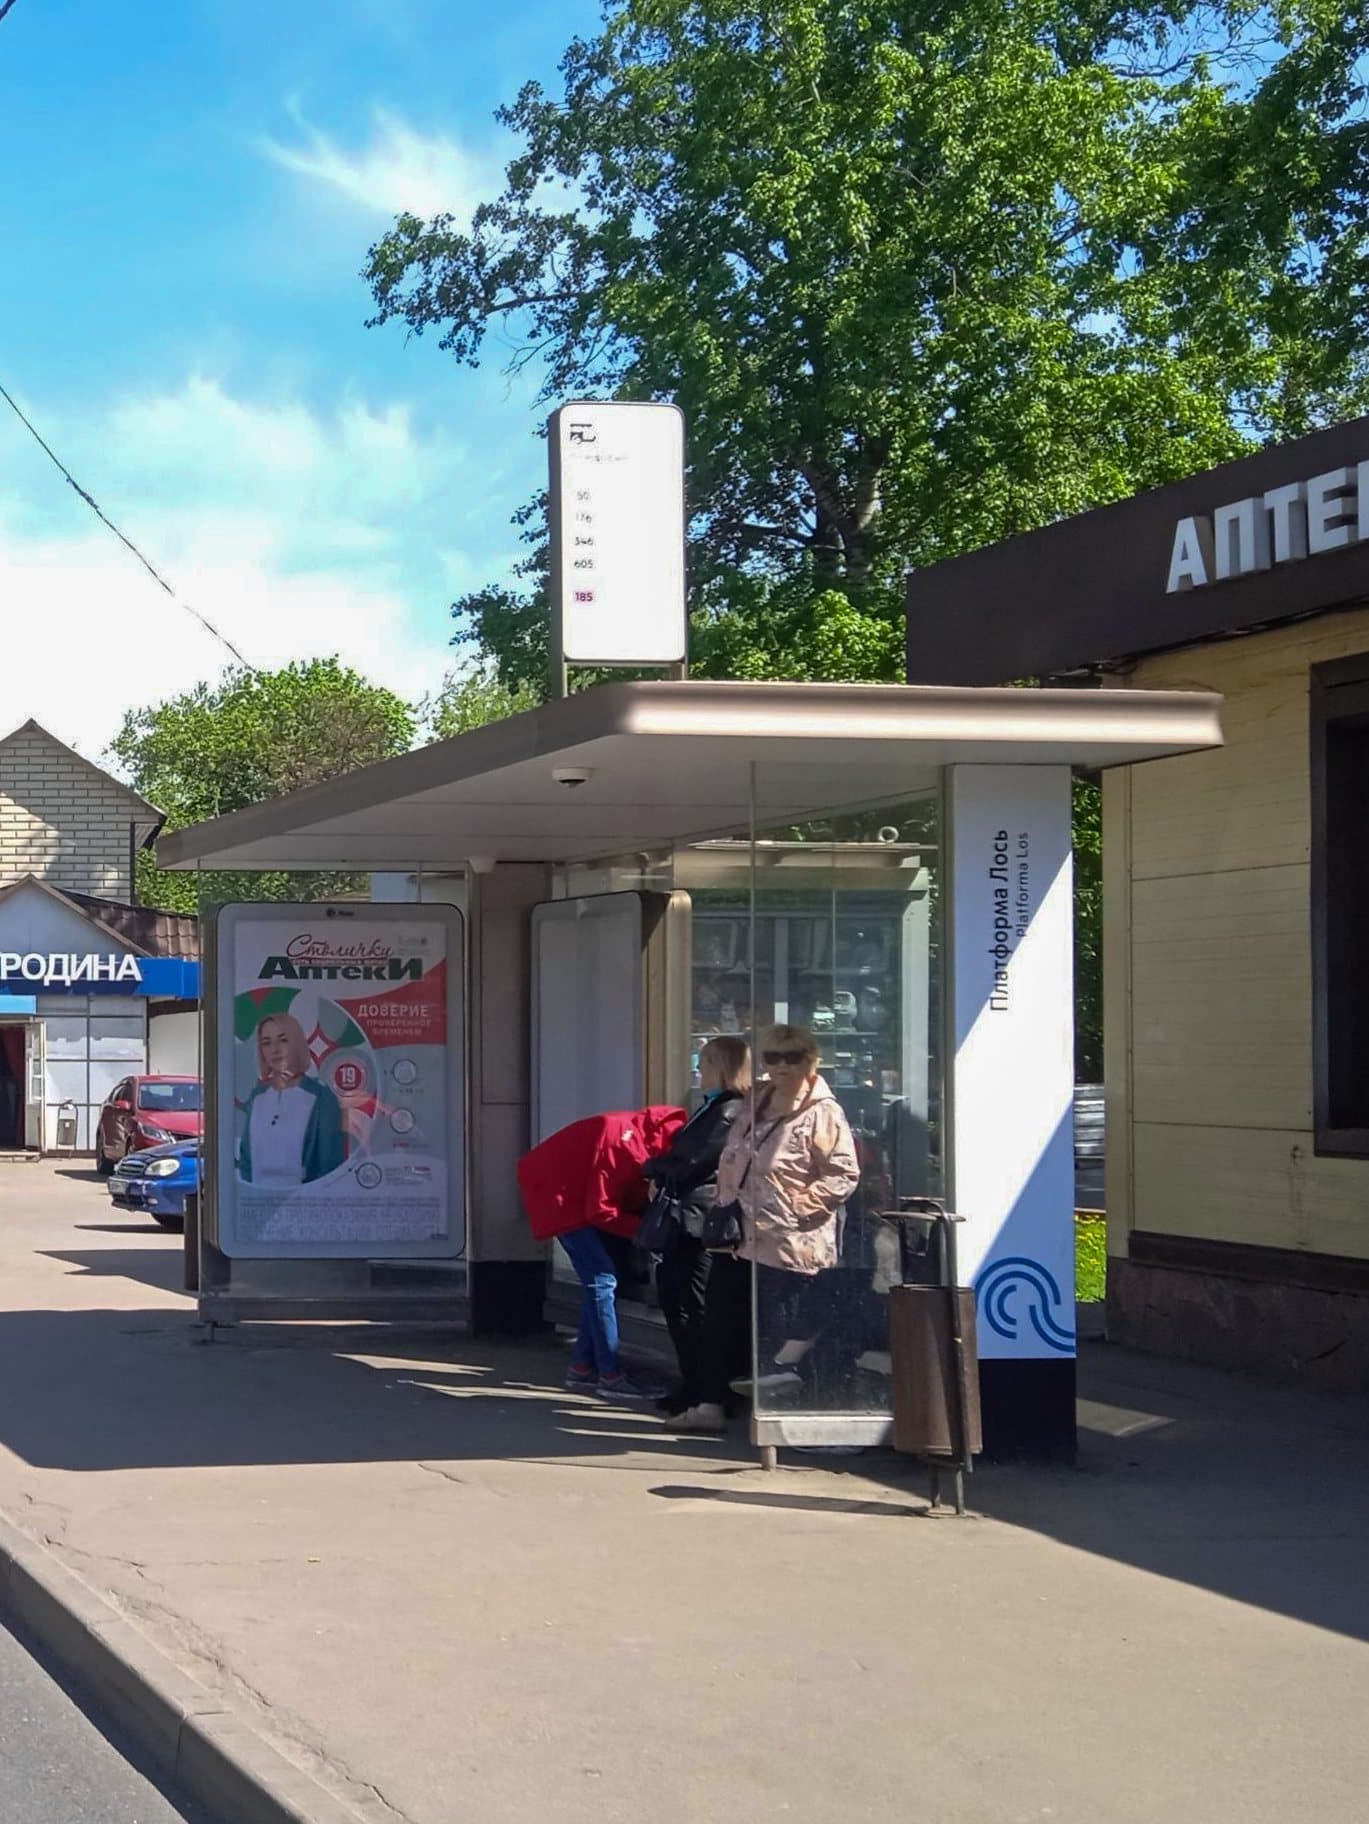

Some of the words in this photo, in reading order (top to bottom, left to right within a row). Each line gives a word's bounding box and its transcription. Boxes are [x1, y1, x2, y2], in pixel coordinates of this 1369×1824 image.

[1166, 459, 1369, 594] АПТЕ
[574, 559, 593, 568] 605
[575, 592, 593, 602] 185
[989, 830, 1008, 882] Лось
[1016, 832, 1029, 858] Los
[1016, 863, 1029, 938] Platforma
[988, 888, 1013, 1011] Платформа
[0, 952, 143, 986] РОДИНА
[358, 1004, 429, 1017] ДОВЕРИЕ
[339, 1067, 356, 1083] 19
